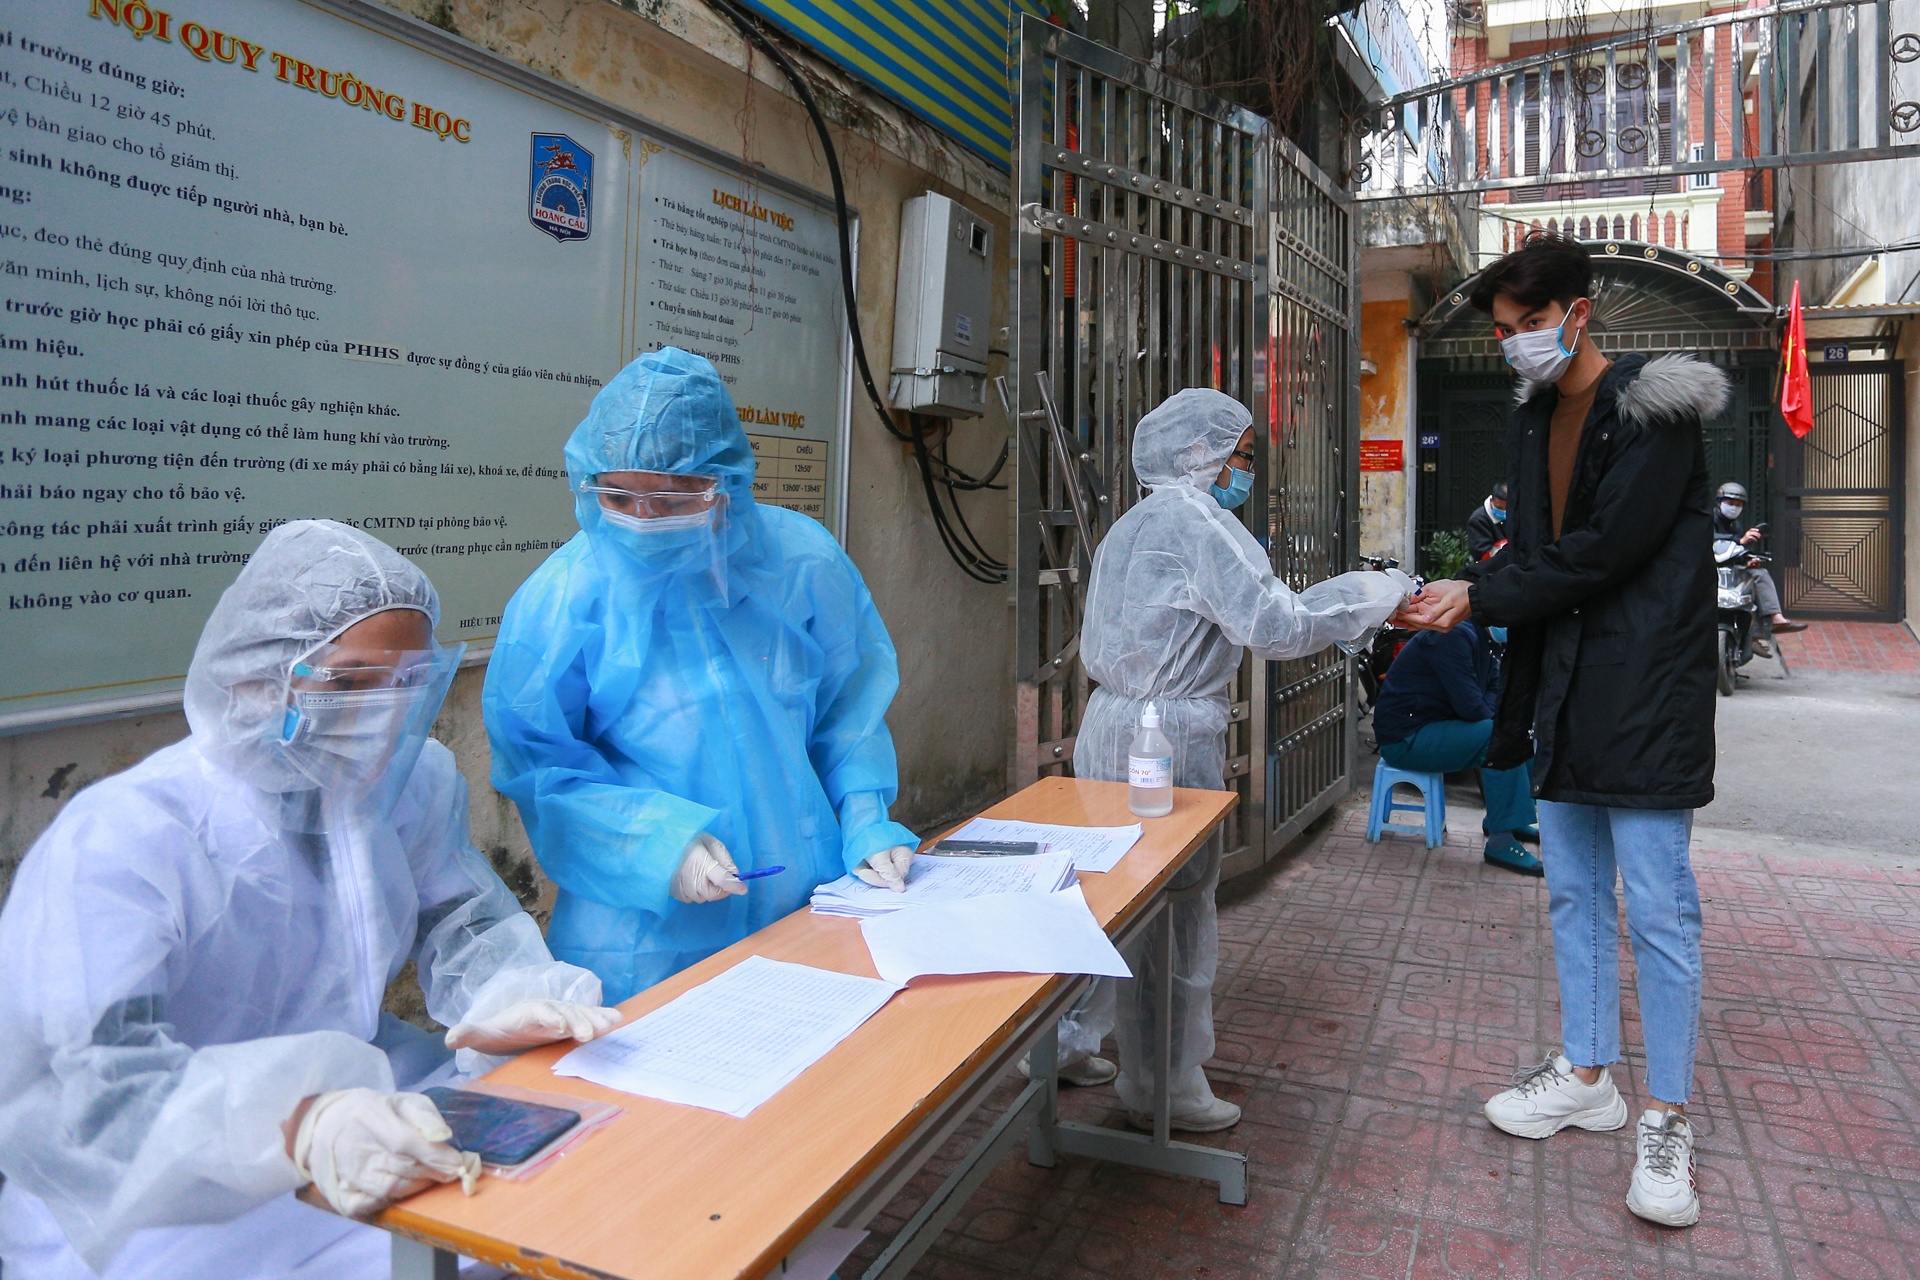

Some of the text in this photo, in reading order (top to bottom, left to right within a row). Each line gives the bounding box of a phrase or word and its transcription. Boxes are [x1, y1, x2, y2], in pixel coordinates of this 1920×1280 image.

[20, 37, 184, 98] trường đúng giờ:
[90, 0, 472, 142] NỘI QUY TRƯỜNG HỌC
[24, 75, 215, 140] Chiều 12 giờ 45 phút.
[9, 148, 52, 169] sinh
[60, 158, 121, 188] không
[176, 184, 207, 207] tiếp
[213, 197, 258, 216] người
[263, 205, 295, 227] nhà,
[299, 214, 325, 231] bạn
[329, 221, 348, 236] bè.
[712, 188, 741, 211] LỊCH
[770, 211, 795, 231] VIỆC
[36, 267, 319, 320] minh, lịch sự, không nói lời thô tục.
[6, 298, 63, 318] trước
[70, 307, 101, 324] giờ
[107, 311, 138, 329] học
[144, 317, 182, 333] phải
[188, 323, 205, 336] có
[211, 323, 244, 343] giấy
[248, 331, 271, 344] xin
[276, 335, 310, 352] phép
[315, 340, 338, 353] của
[344, 342, 400, 360] PHHS
[439, 358, 453, 369] sự
[455, 356, 480, 373] đồng
[483, 362, 489, 374] ý
[492, 363, 509, 374] của
[512, 366, 532, 378] giáo
[535, 369, 553, 380] viên
[556, 372, 571, 383] chủ
[574, 375, 602, 388] nhiệm.
[1829, 348, 1844, 359] 26
[35, 415, 450, 450] mang các loại vật dụng có thể làm hung khí vào trường.
[755, 406, 779, 426] LÀM
[782, 411, 805, 430] VIỆC
[12, 447, 558, 480] ký loại phương tiện đến trường (đi xe máy phải có bằng lái xe), khoá xe, để đúng
[51, 515, 507, 538] tác phải xuất trình giấy CMTND tại phòng bảo vệ.
[14, 553, 50, 572] đến
[58, 556, 92, 570] liên
[100, 554, 121, 572] hệ
[127, 554, 154, 567] với
[160, 552, 191, 566] nhà
[196, 550, 251, 569] trường
[431, 543, 464, 556] (trang
[467, 542, 492, 555] phục
[9, 589, 191, 610] không vào cơ quan.
[460, 616, 484, 629] HIỆU
